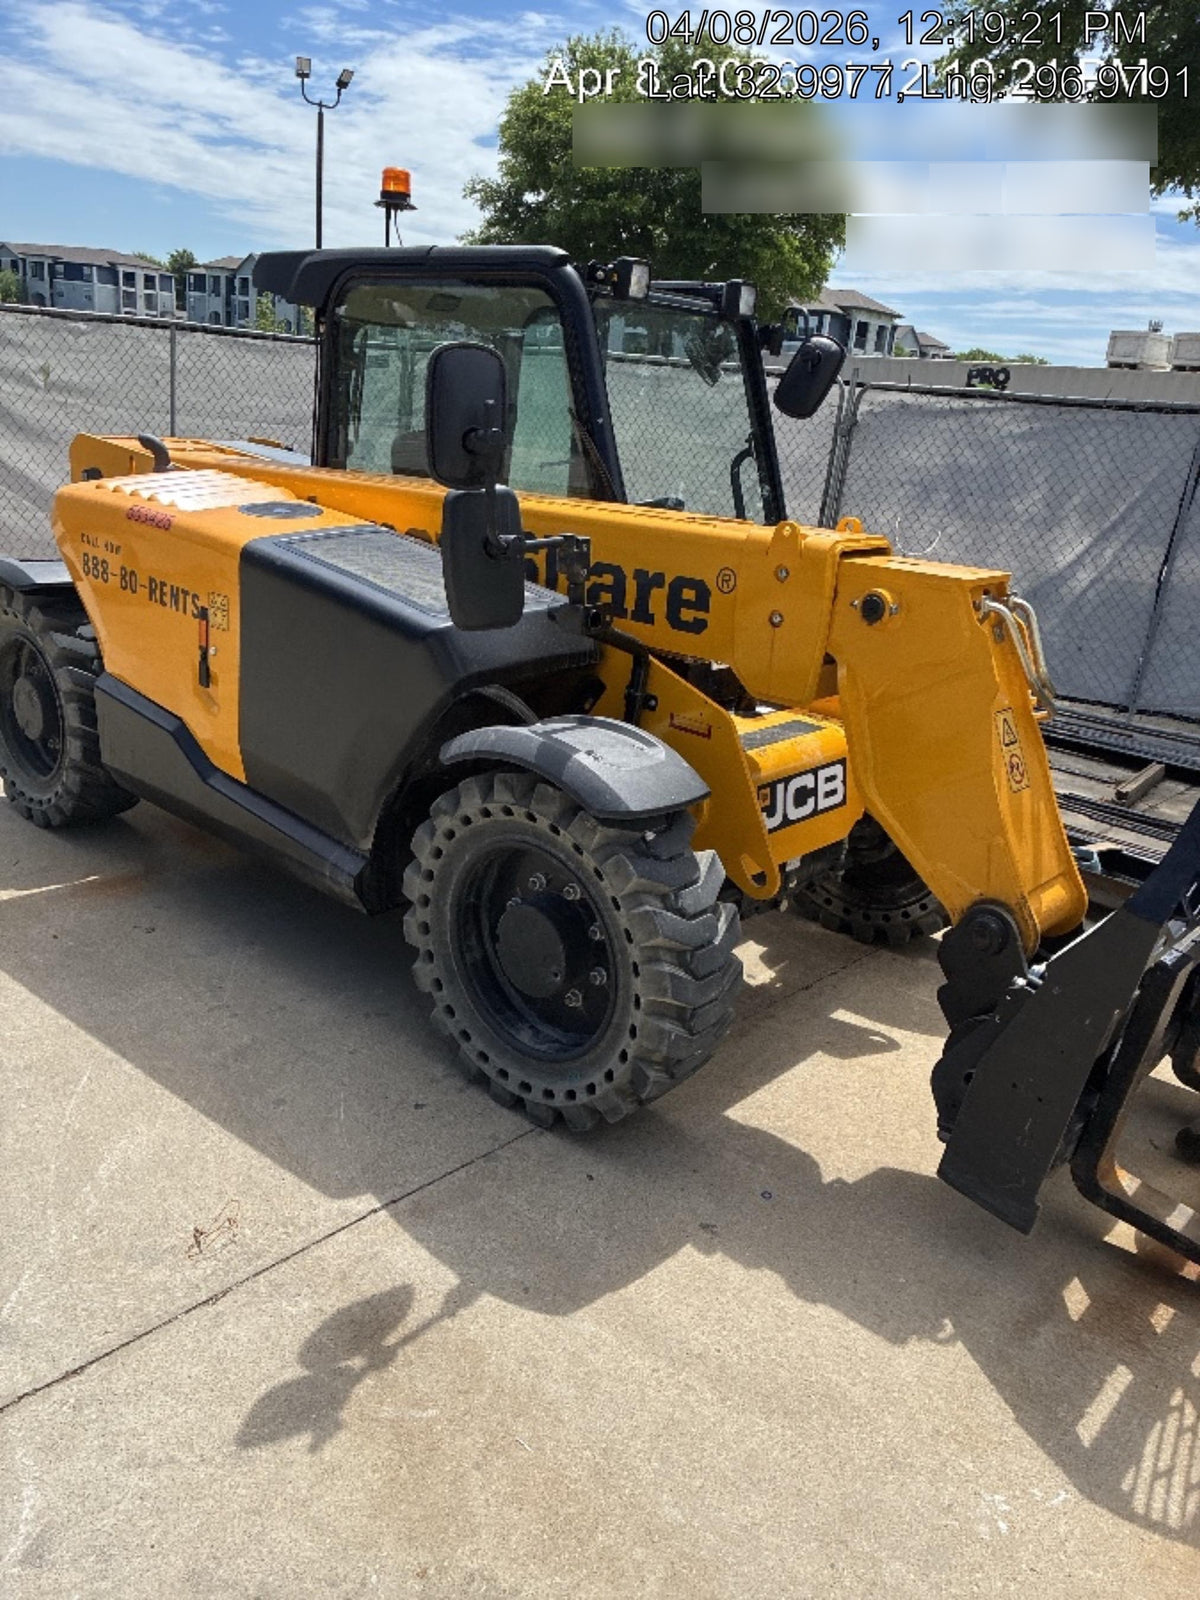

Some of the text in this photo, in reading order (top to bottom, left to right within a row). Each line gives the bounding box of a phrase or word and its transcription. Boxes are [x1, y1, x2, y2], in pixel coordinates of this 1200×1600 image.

[966, 366, 1011, 391] PRO
[82, 552, 201, 620] 888-80-RENTS
[761, 763, 845, 829] JCB
